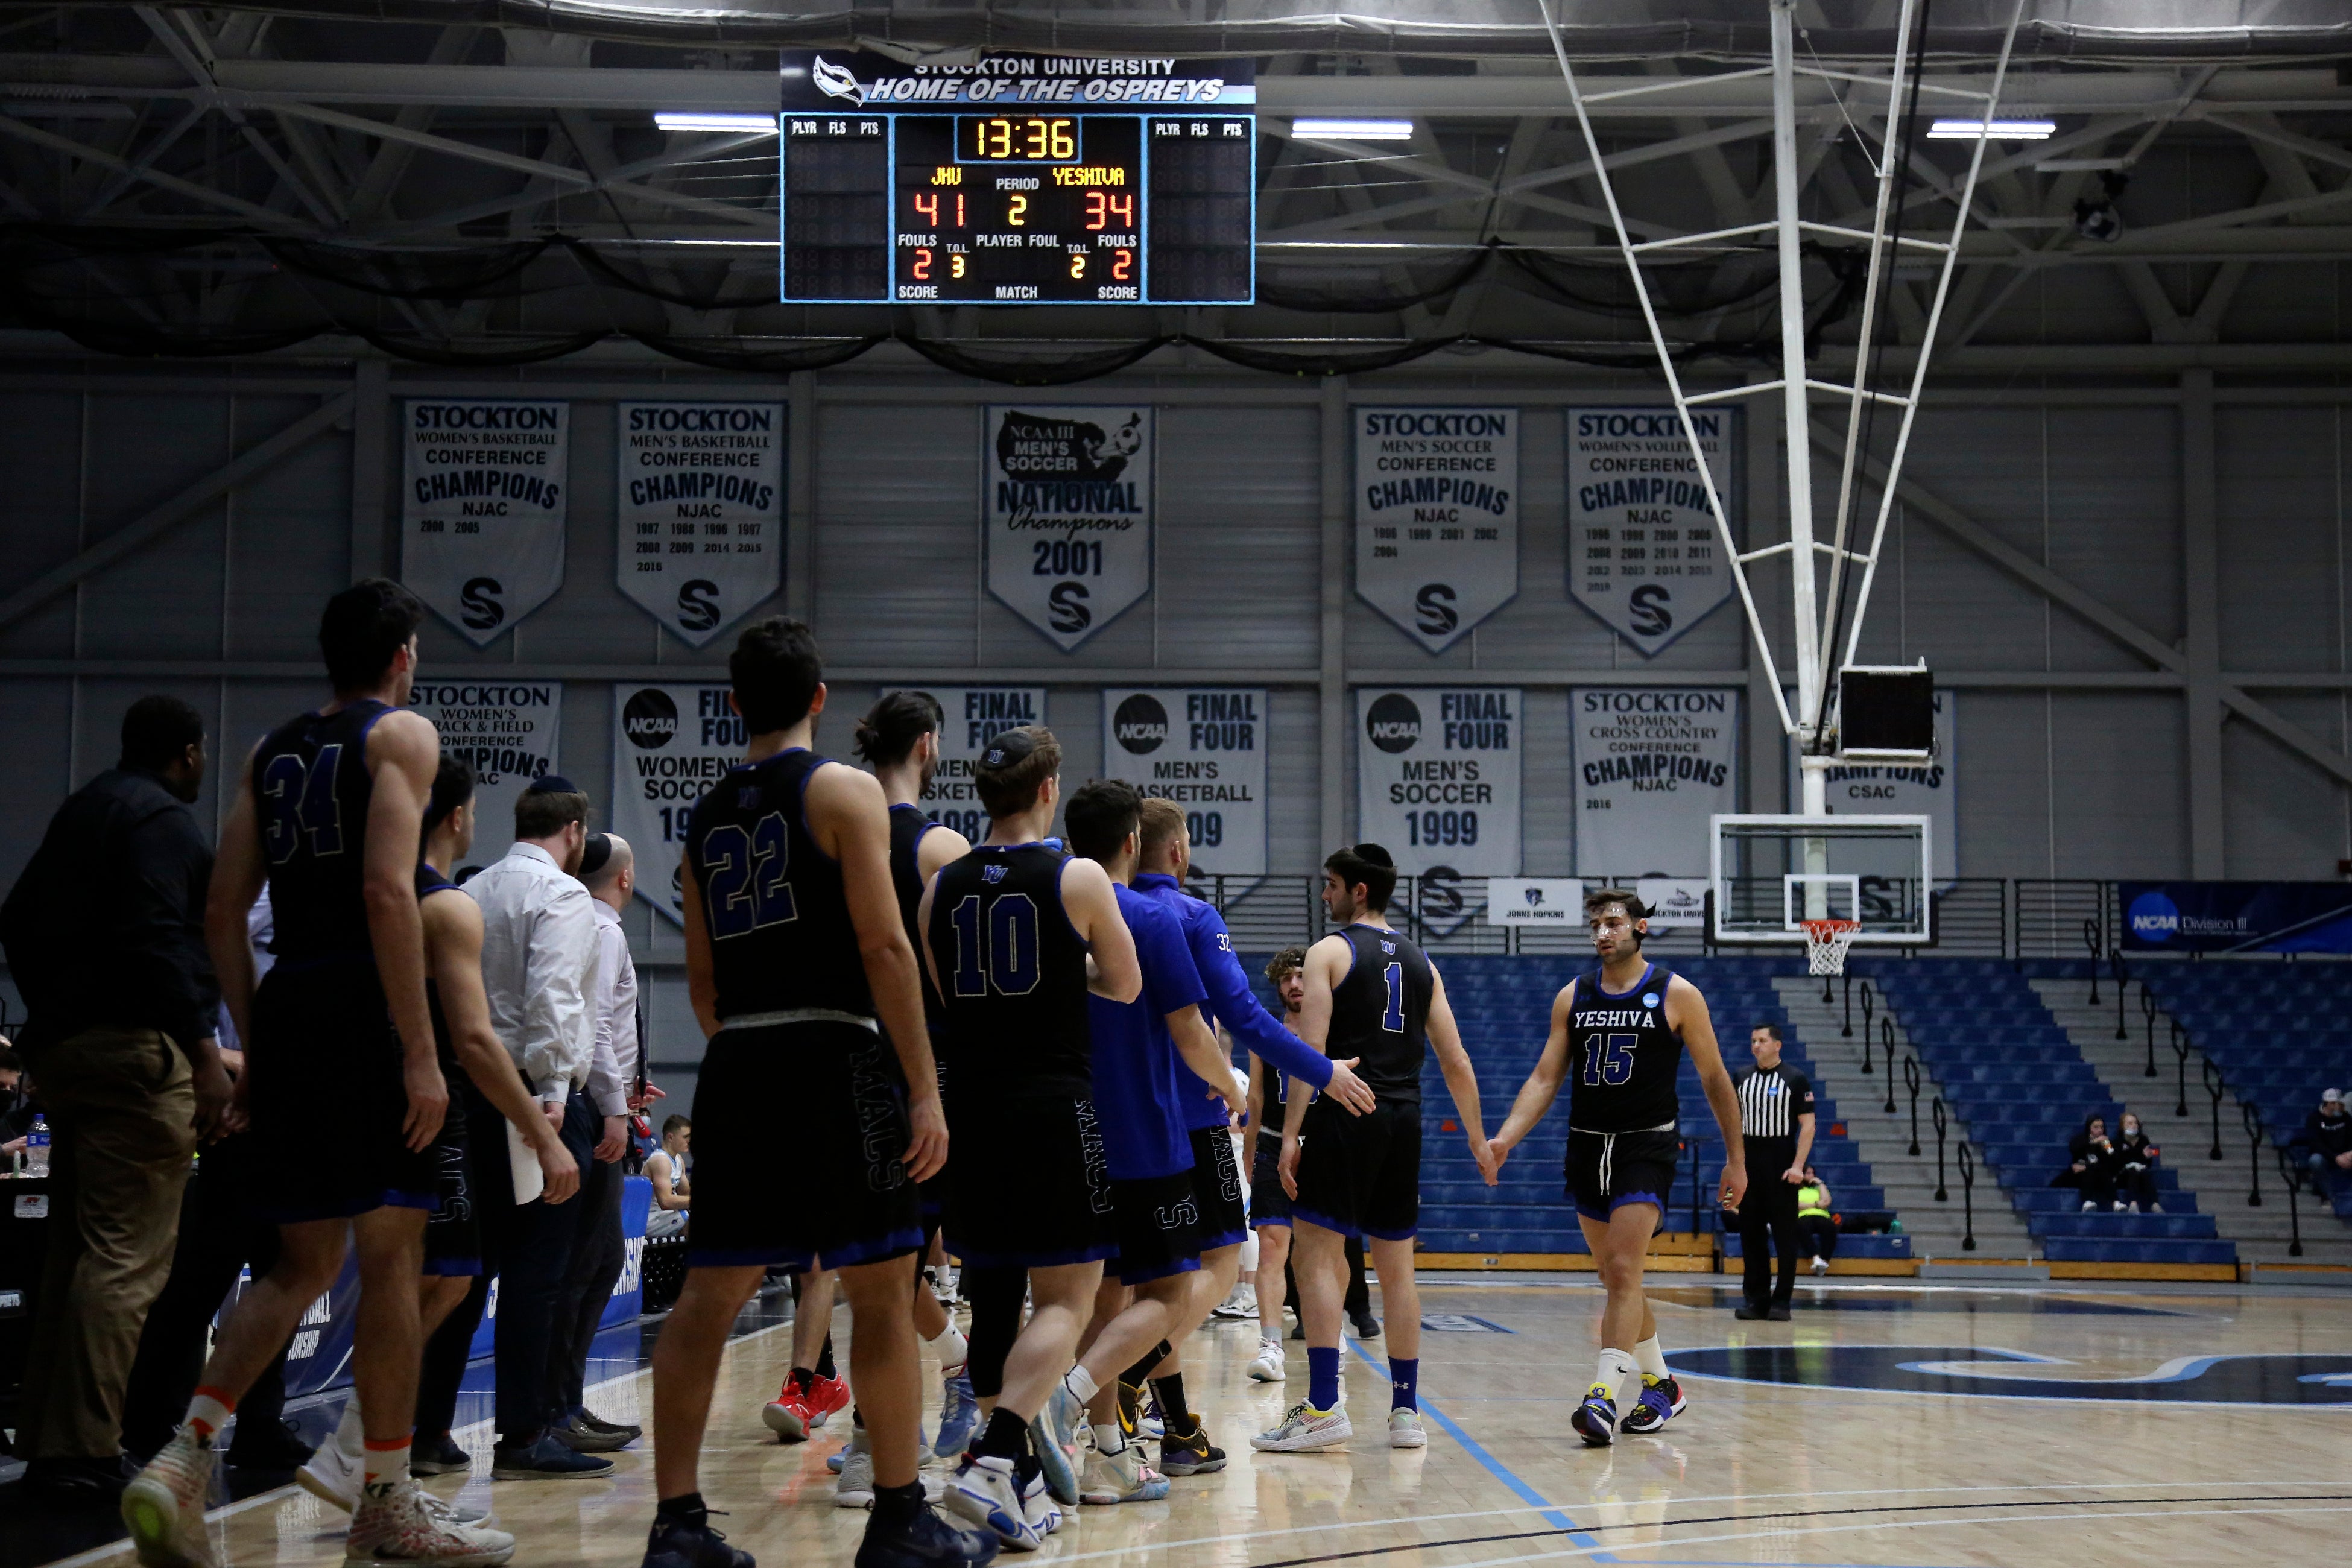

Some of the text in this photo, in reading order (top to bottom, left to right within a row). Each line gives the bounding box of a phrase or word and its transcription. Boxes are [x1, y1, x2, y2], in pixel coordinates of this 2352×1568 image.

[1043, 58, 1176, 75] UNIVERSITY
[870, 78, 1224, 101] HOME OF THE OSPREYS
[792, 121, 879, 136] PLYR FLS PTS
[1155, 122, 1244, 137] PLYR FLS PTS
[978, 120, 1073, 159] 13:36
[931, 167, 961, 185] JHU
[996, 178, 1040, 191] PERIOD
[1052, 167, 1125, 186] YESHIVA
[915, 194, 964, 227] 41
[1008, 195, 1027, 226] 2
[1086, 192, 1133, 230] 34
[898, 234, 937, 247] FOULS
[946, 244, 970, 253] T.O.L.
[976, 235, 1060, 247] PLAYER FOUL
[1067, 244, 1090, 254] T.O.L.
[1098, 235, 1137, 247] FOULS
[913, 249, 932, 280] 2
[952, 255, 966, 279] 3
[1070, 256, 1086, 279] 2
[1113, 250, 1131, 280] 2
[899, 286, 938, 299] SCORE
[996, 286, 1038, 299] MATCH
[1098, 286, 1137, 299] SCORE
[415, 406, 557, 429] STOCKTON
[630, 409, 770, 431] STOCKTON
[1367, 414, 1506, 436] STOCKTON
[1579, 414, 1719, 436] STOCKTON
[415, 432, 557, 445] WOMEN'S BASKETBALL
[1009, 425, 1075, 439] NCAA III
[630, 435, 770, 449] MEN'S BASKETBALL
[1014, 441, 1070, 456] MEN'S
[1381, 440, 1492, 453] MEN'S SOCCER
[1579, 441, 1718, 452] WOMEN'S VOLLEYALL
[426, 450, 546, 466] CONFERENCE
[640, 452, 760, 467] CONFERENCE
[1005, 457, 1078, 472] SOCCER
[1377, 457, 1496, 472] CONFERENCE
[1590, 458, 1709, 472] CONFERENC
[415, 470, 559, 510] CHAMPIONS
[630, 472, 773, 511] CHAMPIONS
[997, 481, 1142, 513] NATIONAL
[1368, 478, 1508, 515] CHAMPIONS
[463, 502, 508, 516] NJAC
[677, 504, 722, 518] NJAC
[1414, 509, 1459, 522] NJAC
[1627, 510, 1673, 523] NJAC
[1008, 504, 1134, 540] Champions
[704, 543, 730, 552] 2014
[738, 543, 762, 553] 2015
[1033, 541, 1103, 575] 2001
[409, 686, 549, 706] STOCKTON
[1584, 693, 1725, 713] STOCKTON
[440, 708, 516, 720] WOMEN'S
[966, 692, 1037, 720] FINAL
[1187, 694, 1258, 721] FINAL
[1441, 694, 1512, 721] FINAL
[432, 721, 534, 732] RACK & FIELD
[628, 717, 677, 734] NCAA
[1617, 715, 1692, 727] WOMEN'S
[701, 719, 748, 746] FOU
[1119, 723, 1168, 740] NCAA
[1190, 723, 1253, 750] FOUR
[1372, 722, 1420, 739] NCAA
[1444, 723, 1508, 750] FOUR
[1590, 727, 1720, 739] CROSS COUNTRY
[440, 736, 524, 746] ONFERENCE
[1609, 742, 1701, 753] CONFERENCE
[449, 748, 549, 779] MPIONS
[636, 756, 741, 777] WOMEN'
[933, 760, 977, 777] MEN
[1154, 761, 1218, 779] MEN'S
[1403, 760, 1479, 781] MEN'S
[1584, 754, 1728, 787] CHAMPIONS
[477, 773, 499, 785] AC
[1633, 779, 1678, 792] NJAC
[1822, 765, 1945, 788] AMPIONS
[644, 779, 715, 800] SOCC
[1136, 785, 1253, 801] ASKETBALL
[1390, 784, 1492, 804] SOCCER
[1848, 785, 1896, 799] CSAC
[263, 743, 344, 865] 34
[1587, 799, 1611, 809] 2016
[659, 806, 692, 842] 19
[1186, 811, 1222, 847] 09
[1405, 811, 1478, 846] 1999
[703, 810, 800, 941] 22
[981, 865, 1008, 884] YU
[1534, 909, 1564, 918] HOPKINS
[2133, 915, 2247, 931] NCAA Division III
[951, 893, 1041, 997] 10
[1216, 932, 1232, 953] 32
[1380, 940, 1397, 955] YU
[1382, 962, 1405, 1033] 1
[1575, 1010, 1655, 1028] YESHIVA
[1584, 1033, 1639, 1086] 15
